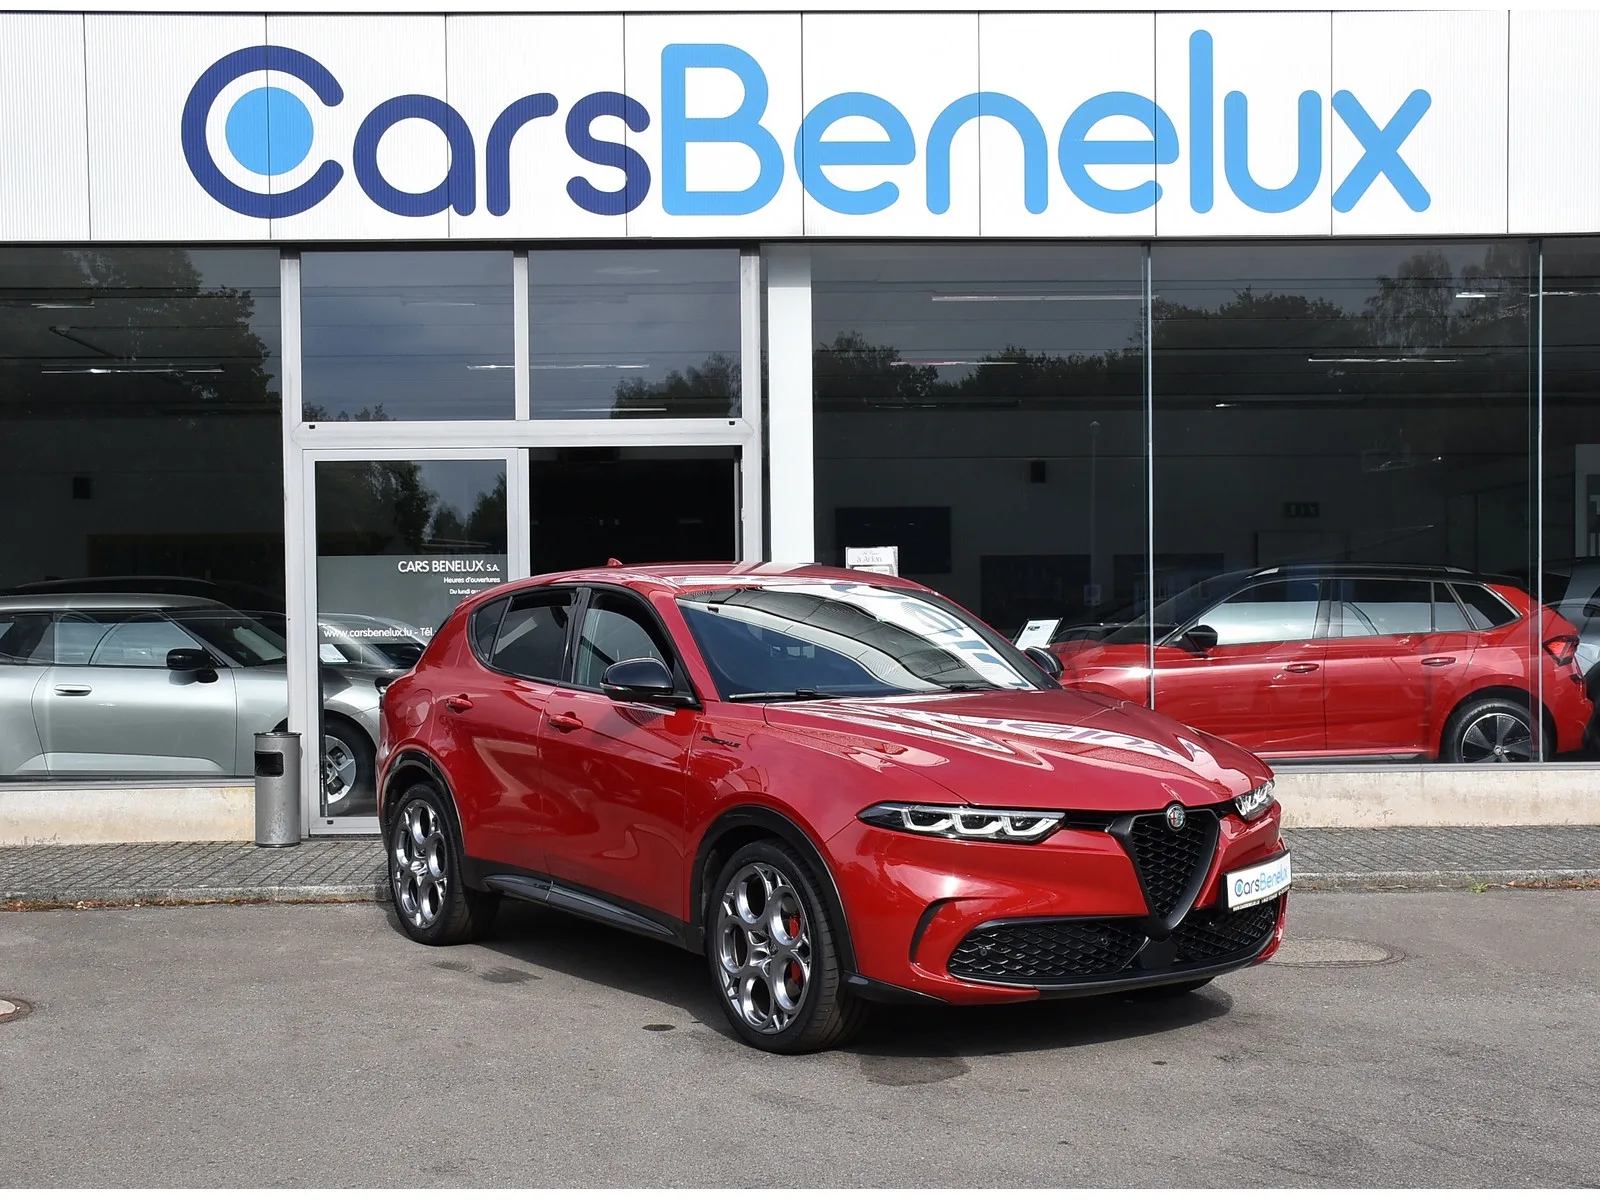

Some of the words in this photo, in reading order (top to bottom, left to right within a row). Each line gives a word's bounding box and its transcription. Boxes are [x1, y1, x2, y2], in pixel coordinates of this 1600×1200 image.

[398, 560, 429, 572] CARS
[432, 560, 484, 572] BENELUX
[323, 627, 412, 637] www.carsbenelux.lu
